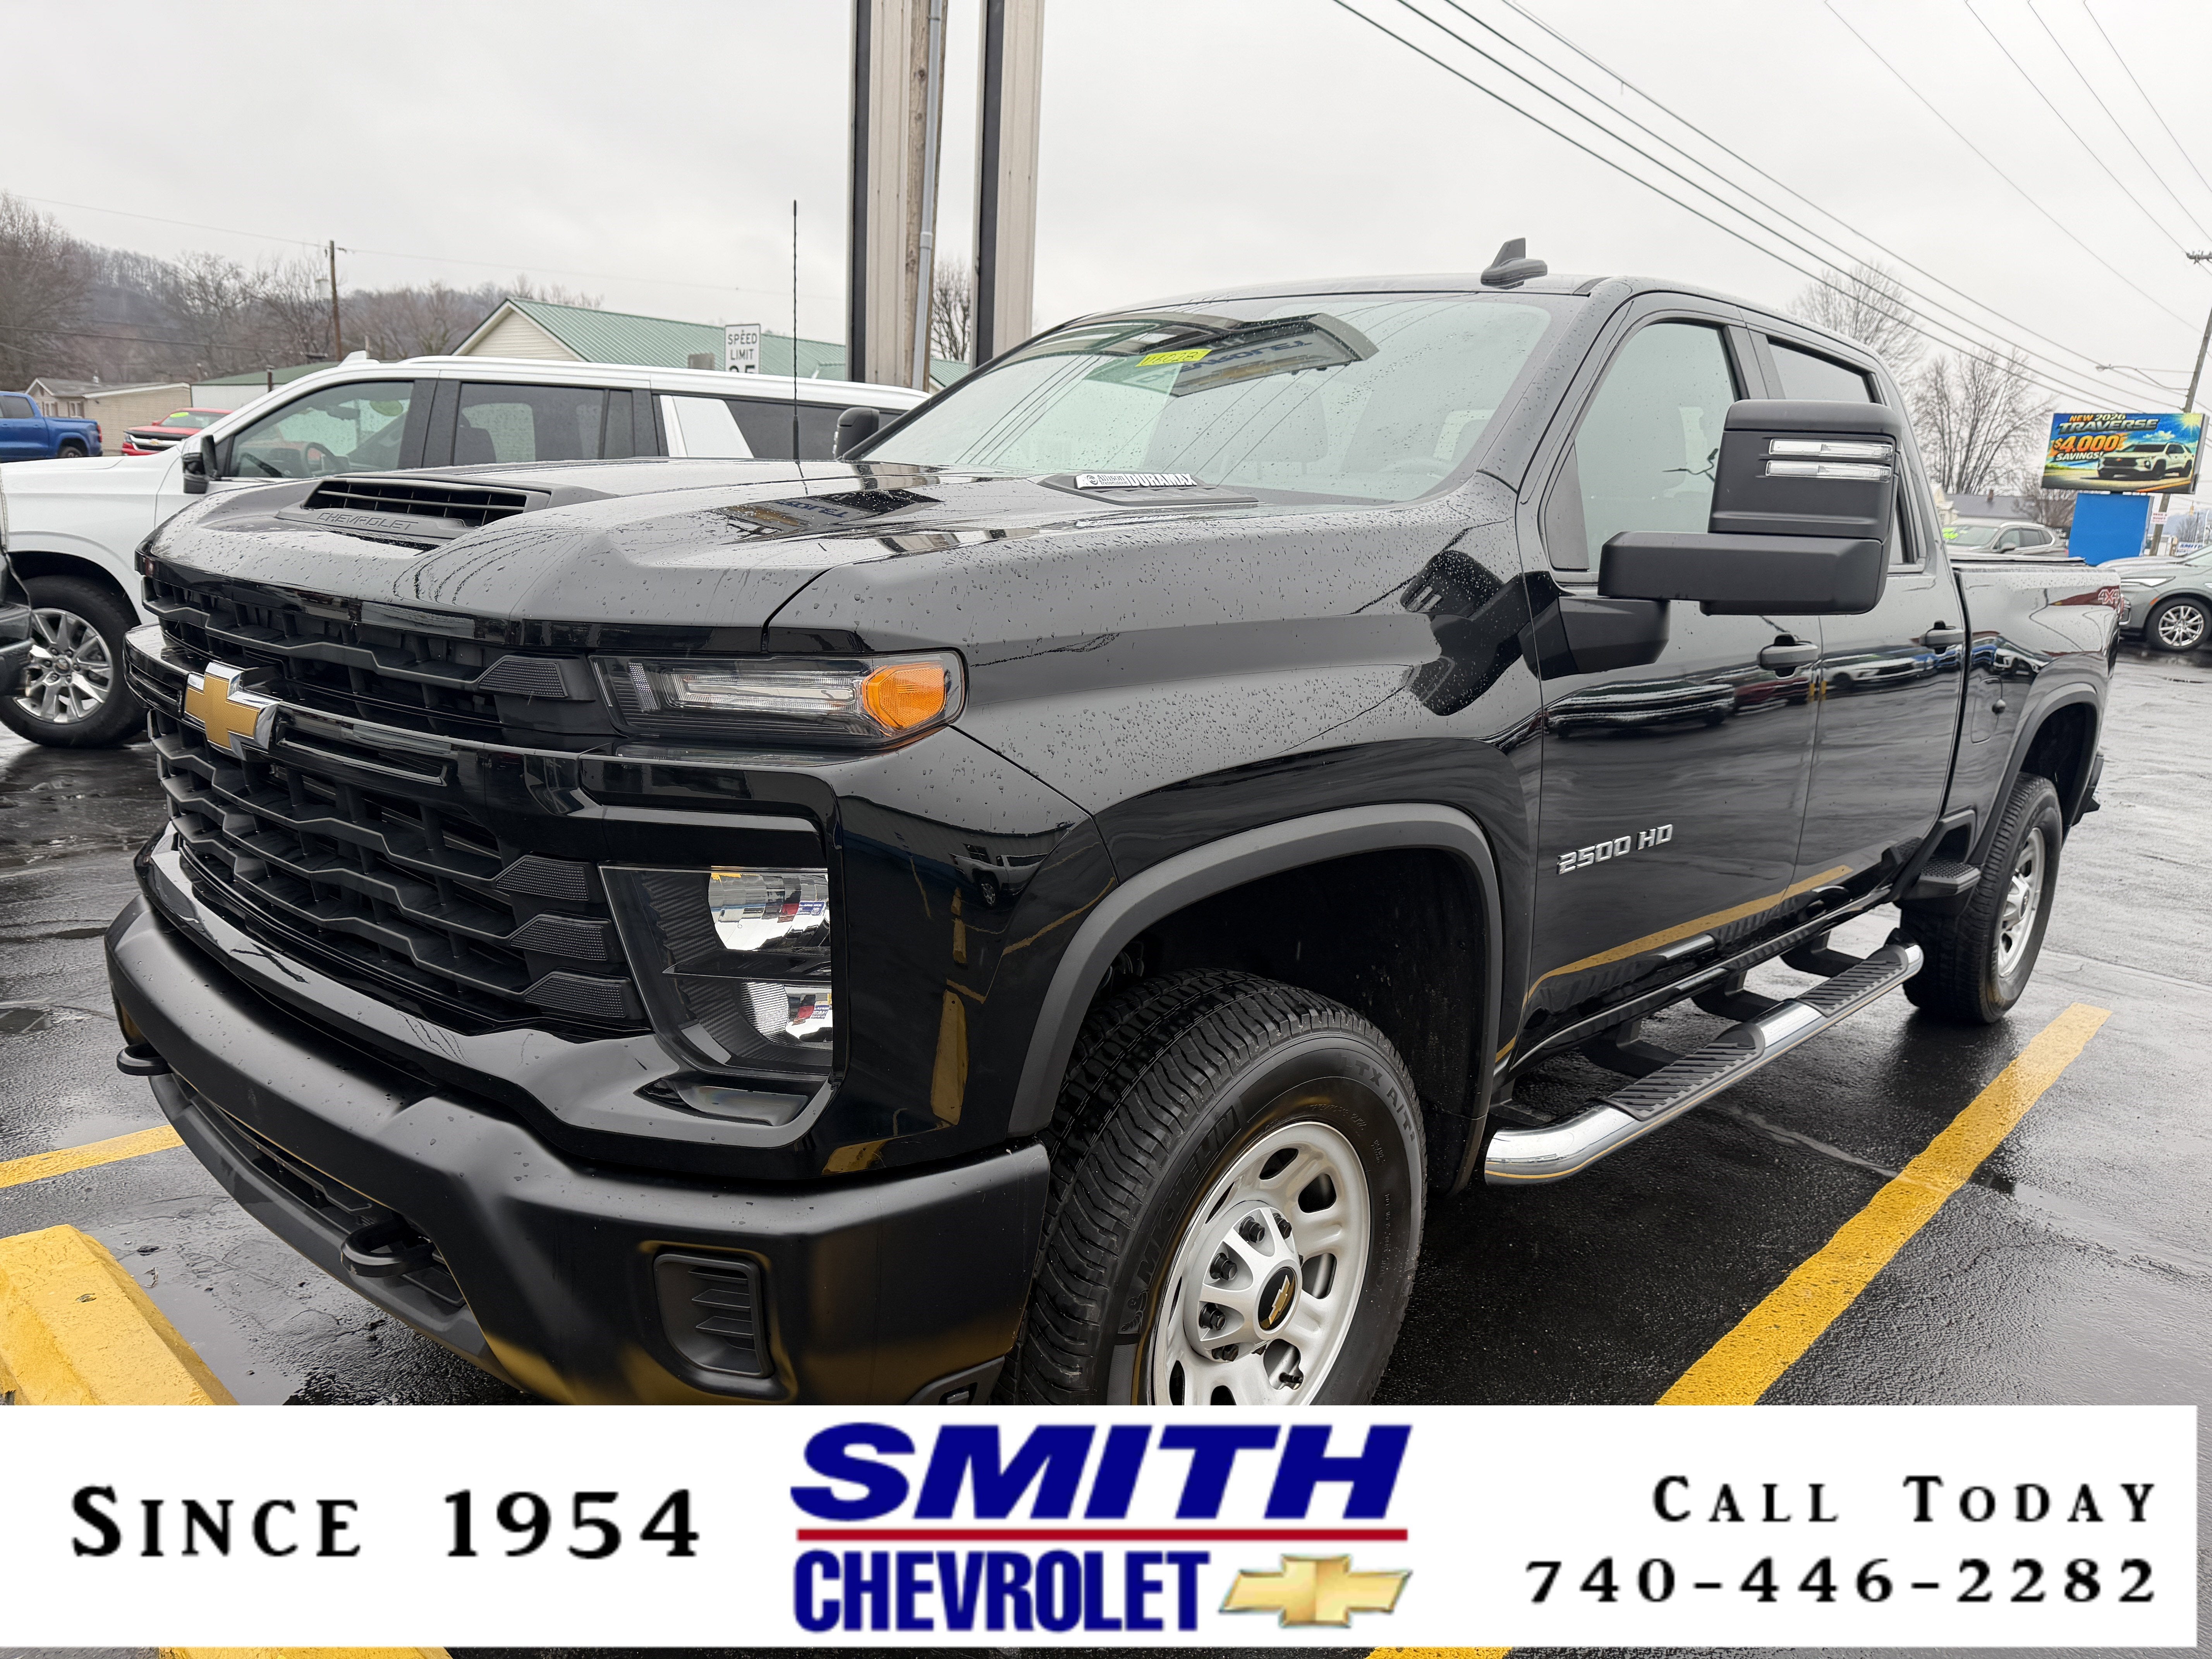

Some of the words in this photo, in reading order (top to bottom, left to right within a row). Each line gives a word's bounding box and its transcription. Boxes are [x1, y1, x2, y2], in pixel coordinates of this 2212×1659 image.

[727, 333, 757, 345] SPEED
[730, 349, 754, 360] LIMIT
[2059, 419, 2159, 432] TRAVERSE
[2056, 451, 2104, 461] SAVINGS!
[1125, 473, 1198, 487] DURAMAX
[316, 512, 419, 531] CHEVROLET
[1557, 835, 1631, 875] 2500
[1637, 823, 1673, 850] HD
